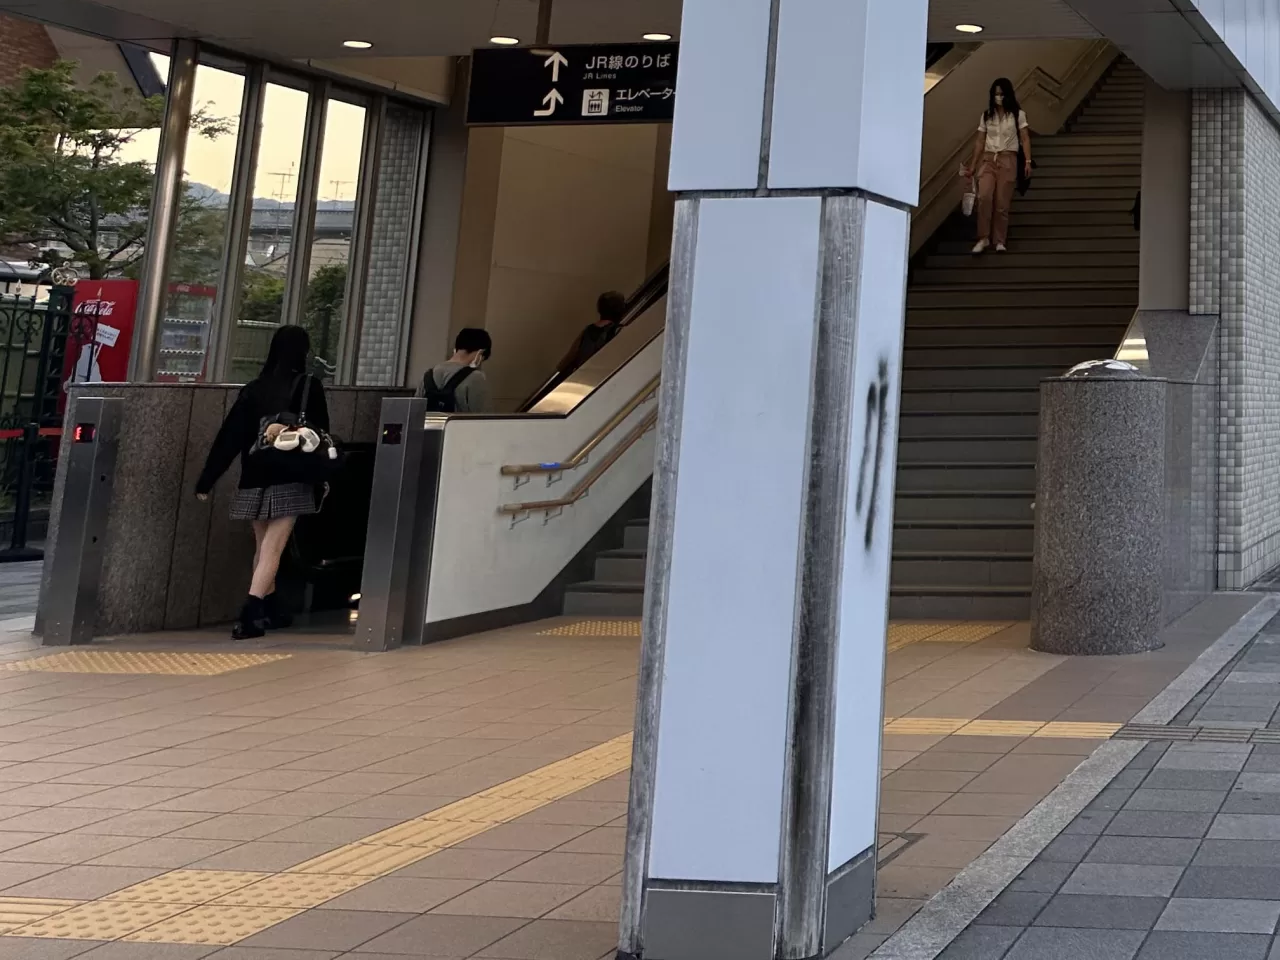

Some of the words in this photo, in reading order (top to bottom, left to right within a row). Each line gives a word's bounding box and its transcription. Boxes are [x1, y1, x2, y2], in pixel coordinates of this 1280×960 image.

[585, 54, 671, 70] JR線のりば
[615, 105, 644, 113] Elevator
[74, 300, 116, 316] CcaCola
